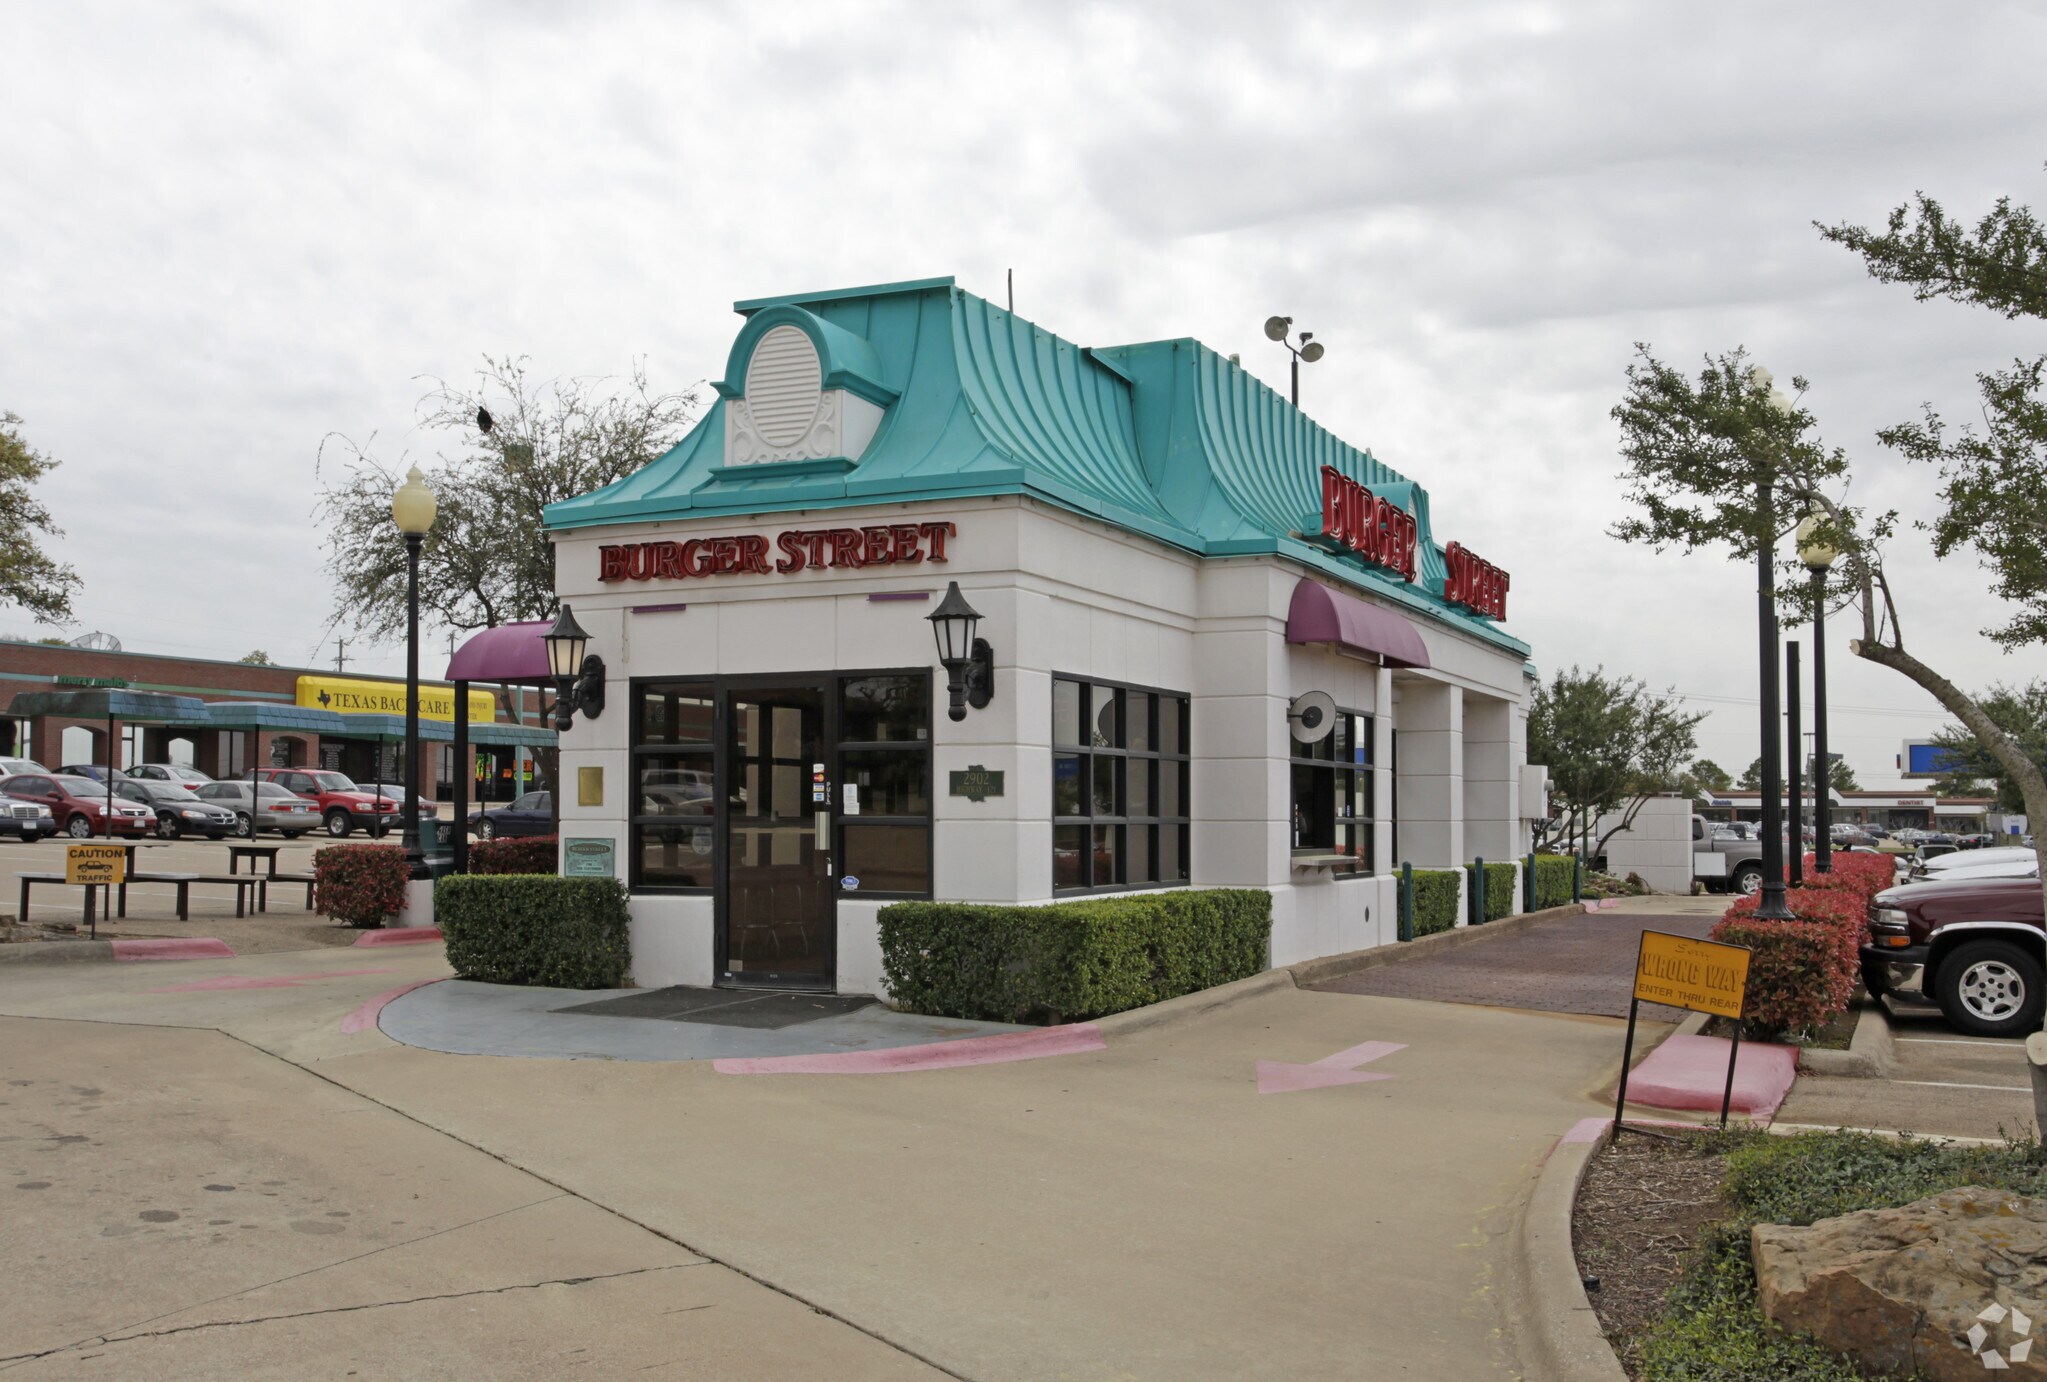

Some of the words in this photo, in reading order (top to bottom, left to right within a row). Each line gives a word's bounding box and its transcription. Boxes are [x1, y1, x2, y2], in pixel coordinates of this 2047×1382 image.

[597, 534, 773, 583] BURGER
[776, 521, 956, 574] STREET
[1320, 465, 1418, 583] BURGER
[1444, 541, 1510, 622] STREET
[333, 693, 377, 709] TEXAS
[380, 696, 408, 711] BAC
[417, 700, 450, 715] CARE
[963, 772, 990, 785] 2902
[69, 848, 123, 859] CAUTION
[76, 874, 113, 882] TRAFFIC
[1642, 952, 1701, 985] WRONG
[1705, 965, 1743, 993] WAY
[1638, 983, 1673, 997] ENTER
[1677, 991, 1706, 1004] THRU
[1709, 998, 1739, 1010] REAR
